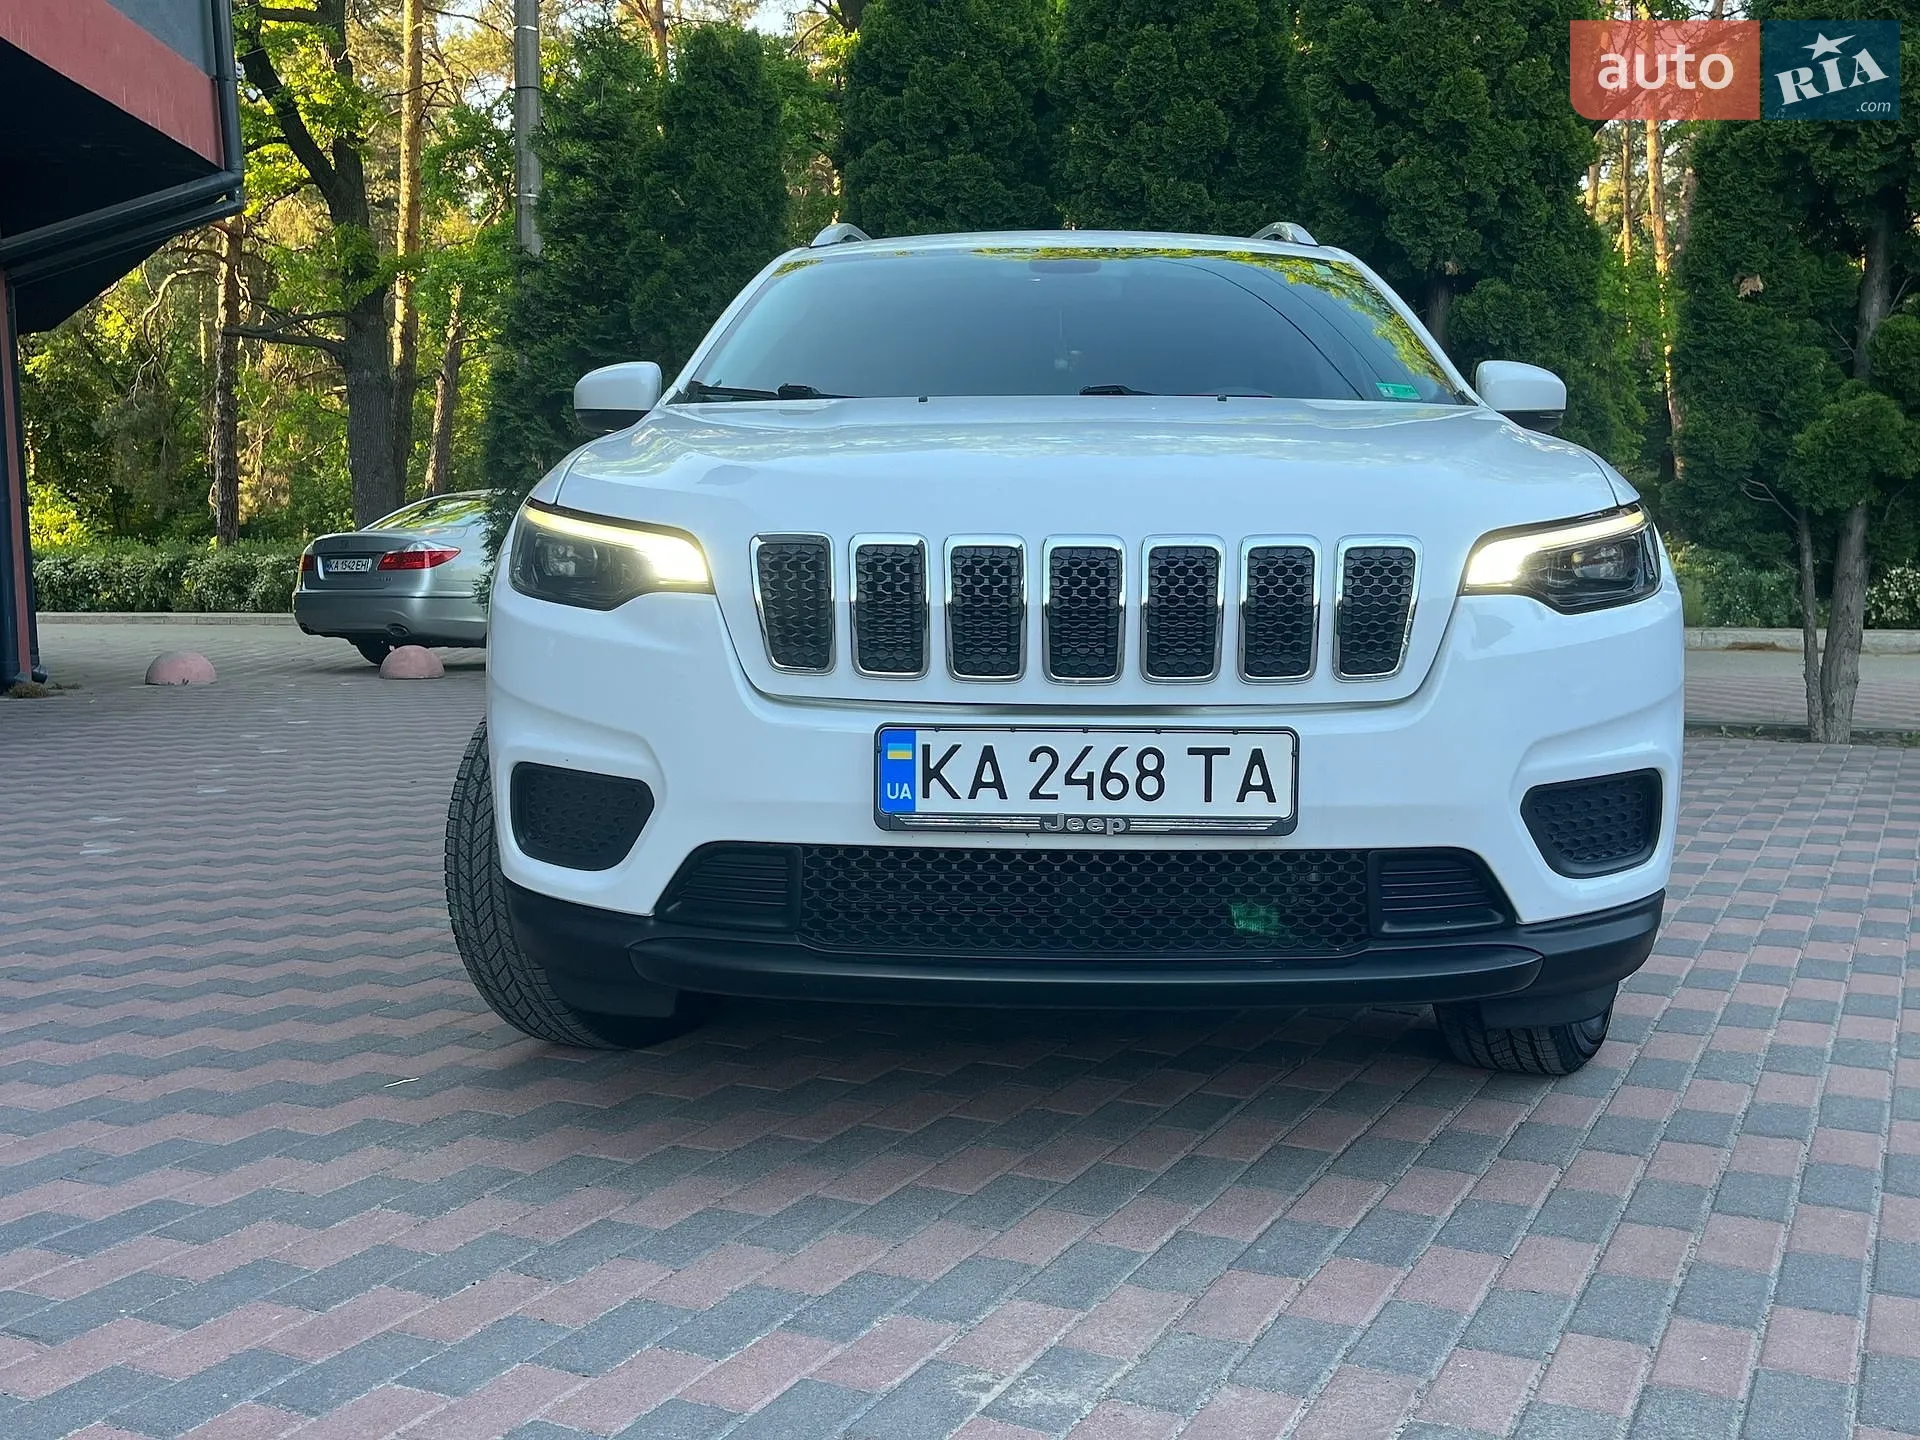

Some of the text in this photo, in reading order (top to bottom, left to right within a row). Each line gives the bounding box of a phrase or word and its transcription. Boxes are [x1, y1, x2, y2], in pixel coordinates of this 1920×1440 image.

[922, 743, 1277, 803] KA 2468 TA
[887, 783, 912, 800] UA
[1043, 813, 1128, 836] Jeep
